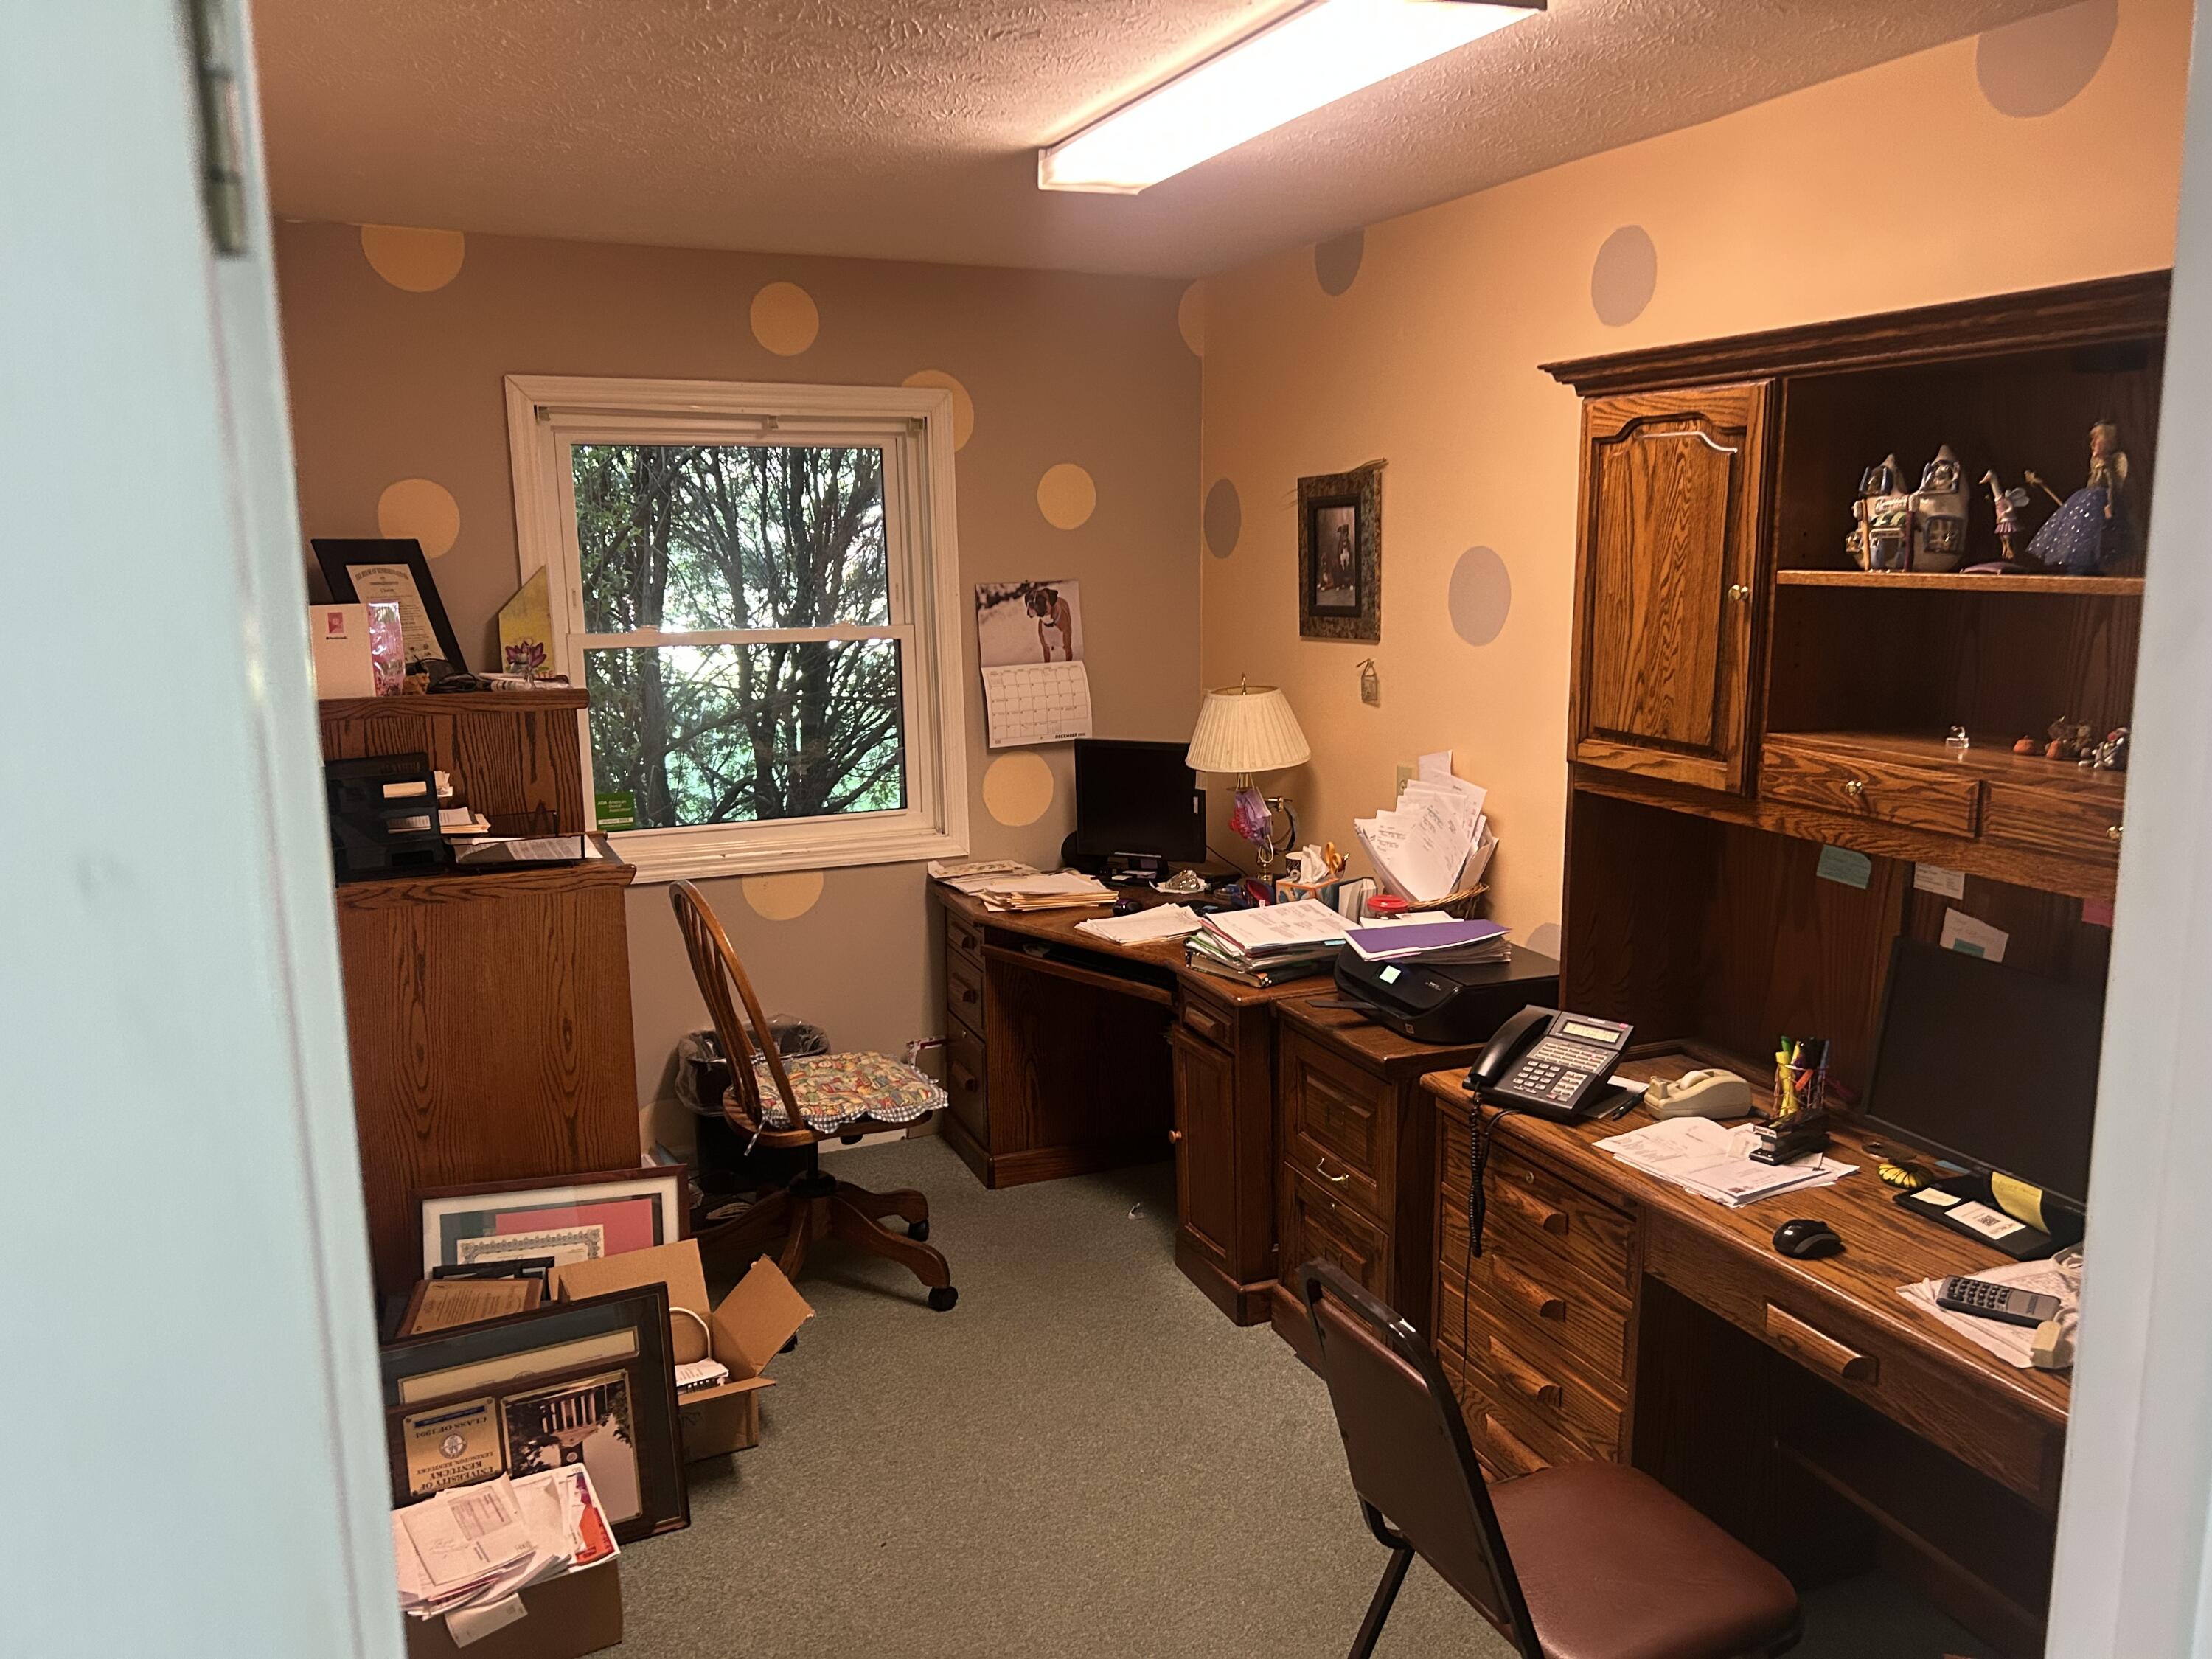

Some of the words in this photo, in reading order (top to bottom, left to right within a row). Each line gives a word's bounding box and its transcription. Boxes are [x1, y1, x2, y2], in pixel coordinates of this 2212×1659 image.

[437, 1425, 453, 1433] OF
[453, 1416, 487, 1430] CLASS
[417, 1461, 453, 1475] KENTUCKY
[429, 1461, 483, 1481] KENTUCKY
[436, 1466, 493, 1487] UNIVERSITY
[420, 1481, 434, 1492] OF
